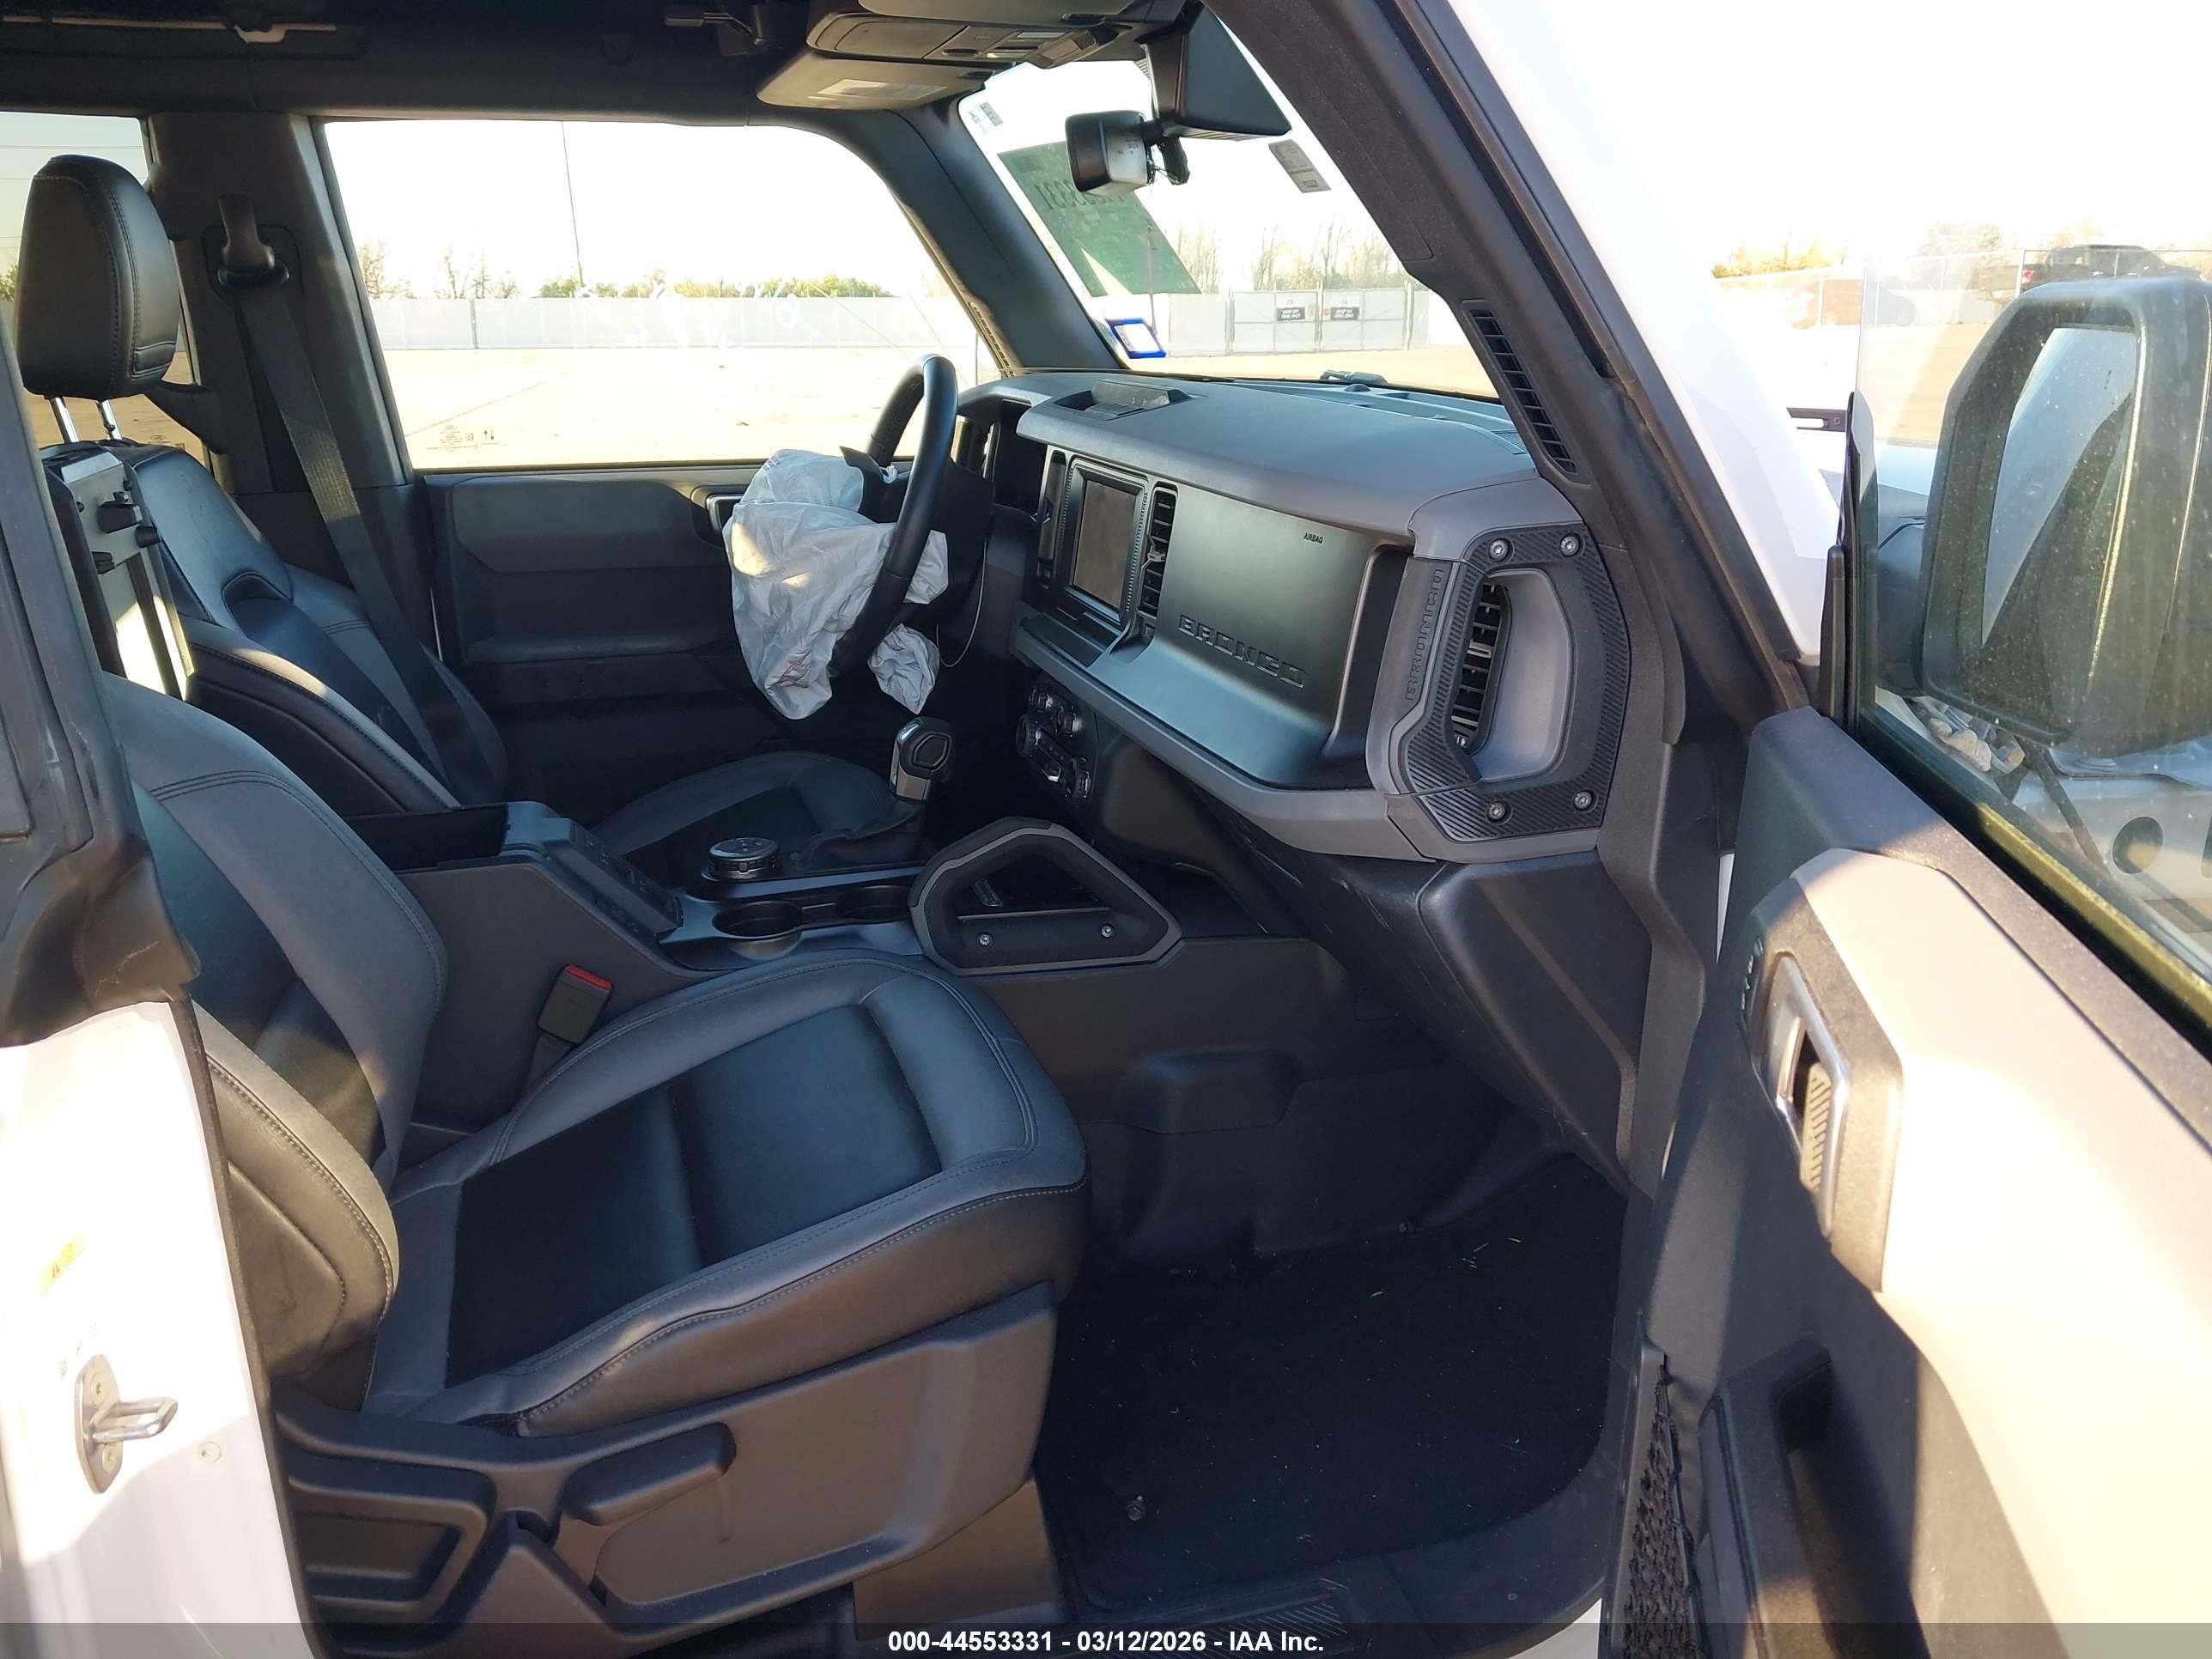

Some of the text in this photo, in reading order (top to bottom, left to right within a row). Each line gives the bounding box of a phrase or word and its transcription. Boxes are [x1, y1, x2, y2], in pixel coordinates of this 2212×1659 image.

[1303, 532, 1324, 544] AIRBAG
[1177, 613, 1306, 690] BRONCO
[1404, 568, 1444, 702] BRONCO
